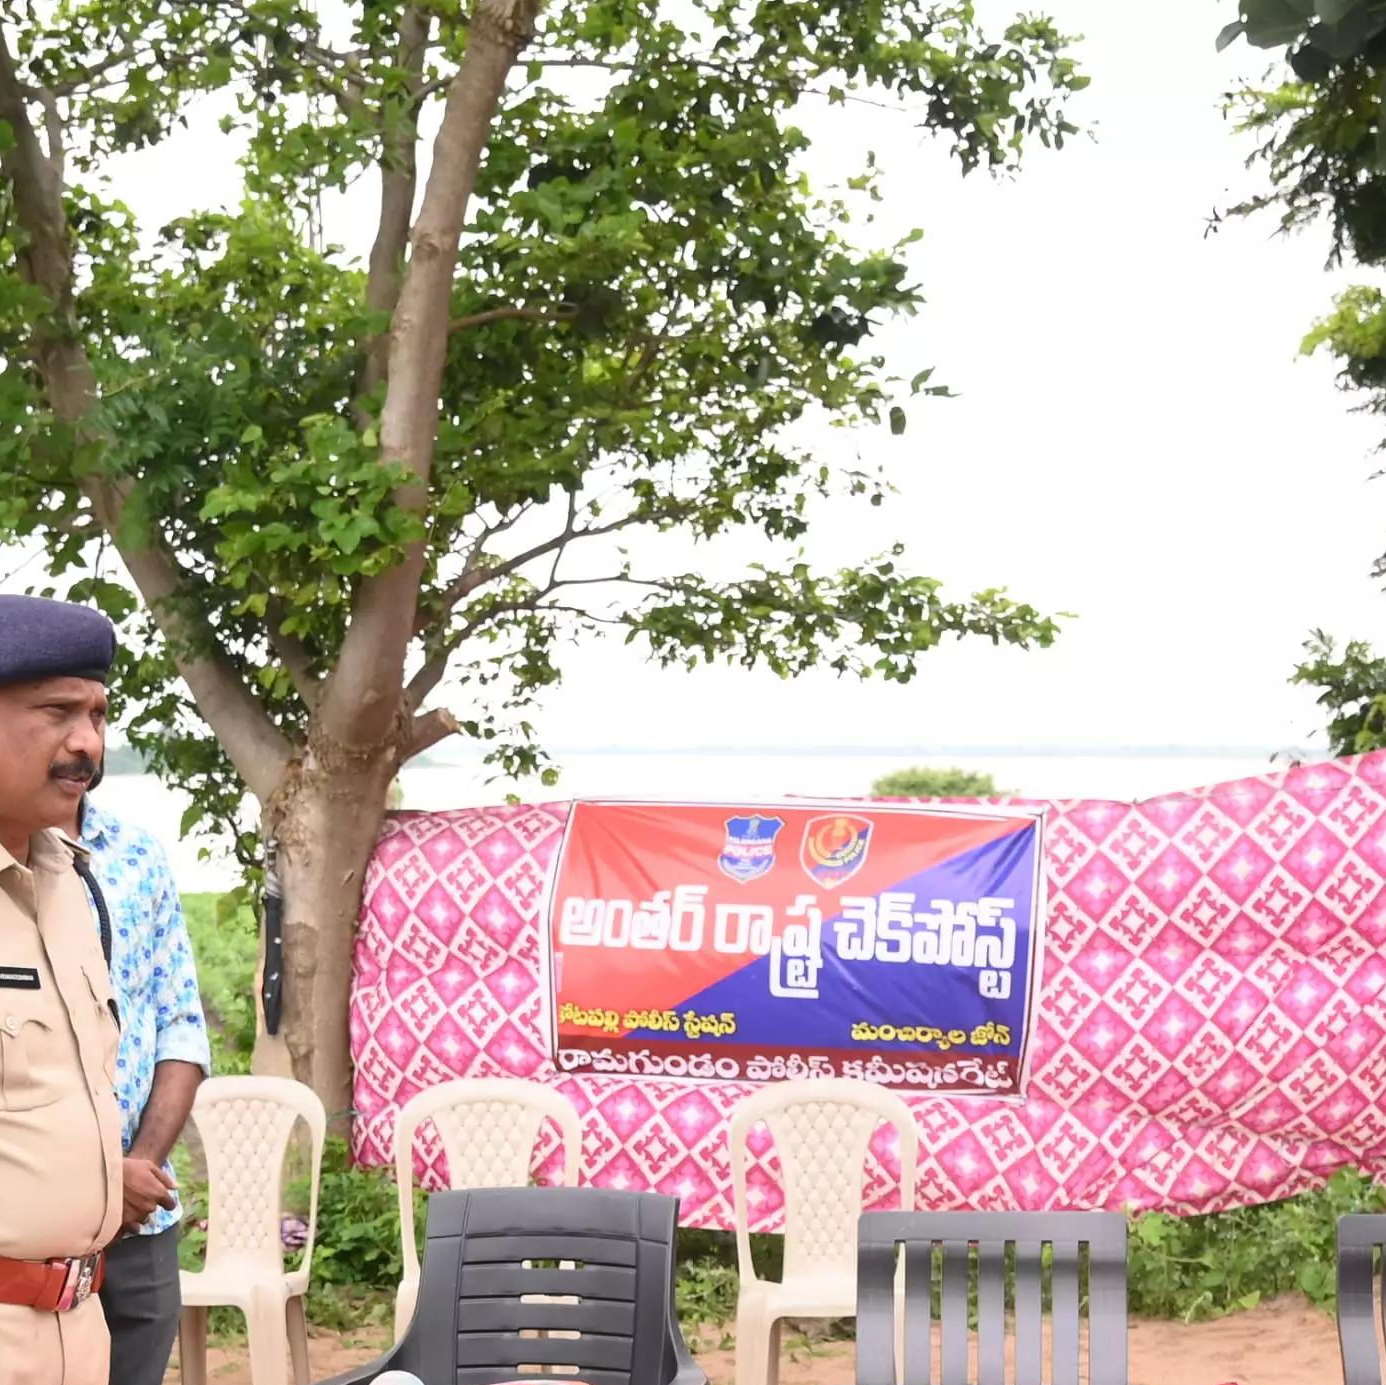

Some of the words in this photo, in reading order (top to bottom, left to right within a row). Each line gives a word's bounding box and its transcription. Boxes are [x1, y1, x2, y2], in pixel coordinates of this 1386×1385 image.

[559, 884, 708, 952] అంతర్
[714, 894, 821, 999] రాష్ట్ర
[623, 1009, 680, 1031] పోలీస్
[683, 1010, 736, 1039] స్టేషన్
[558, 1048, 740, 1079] రామగుండం
